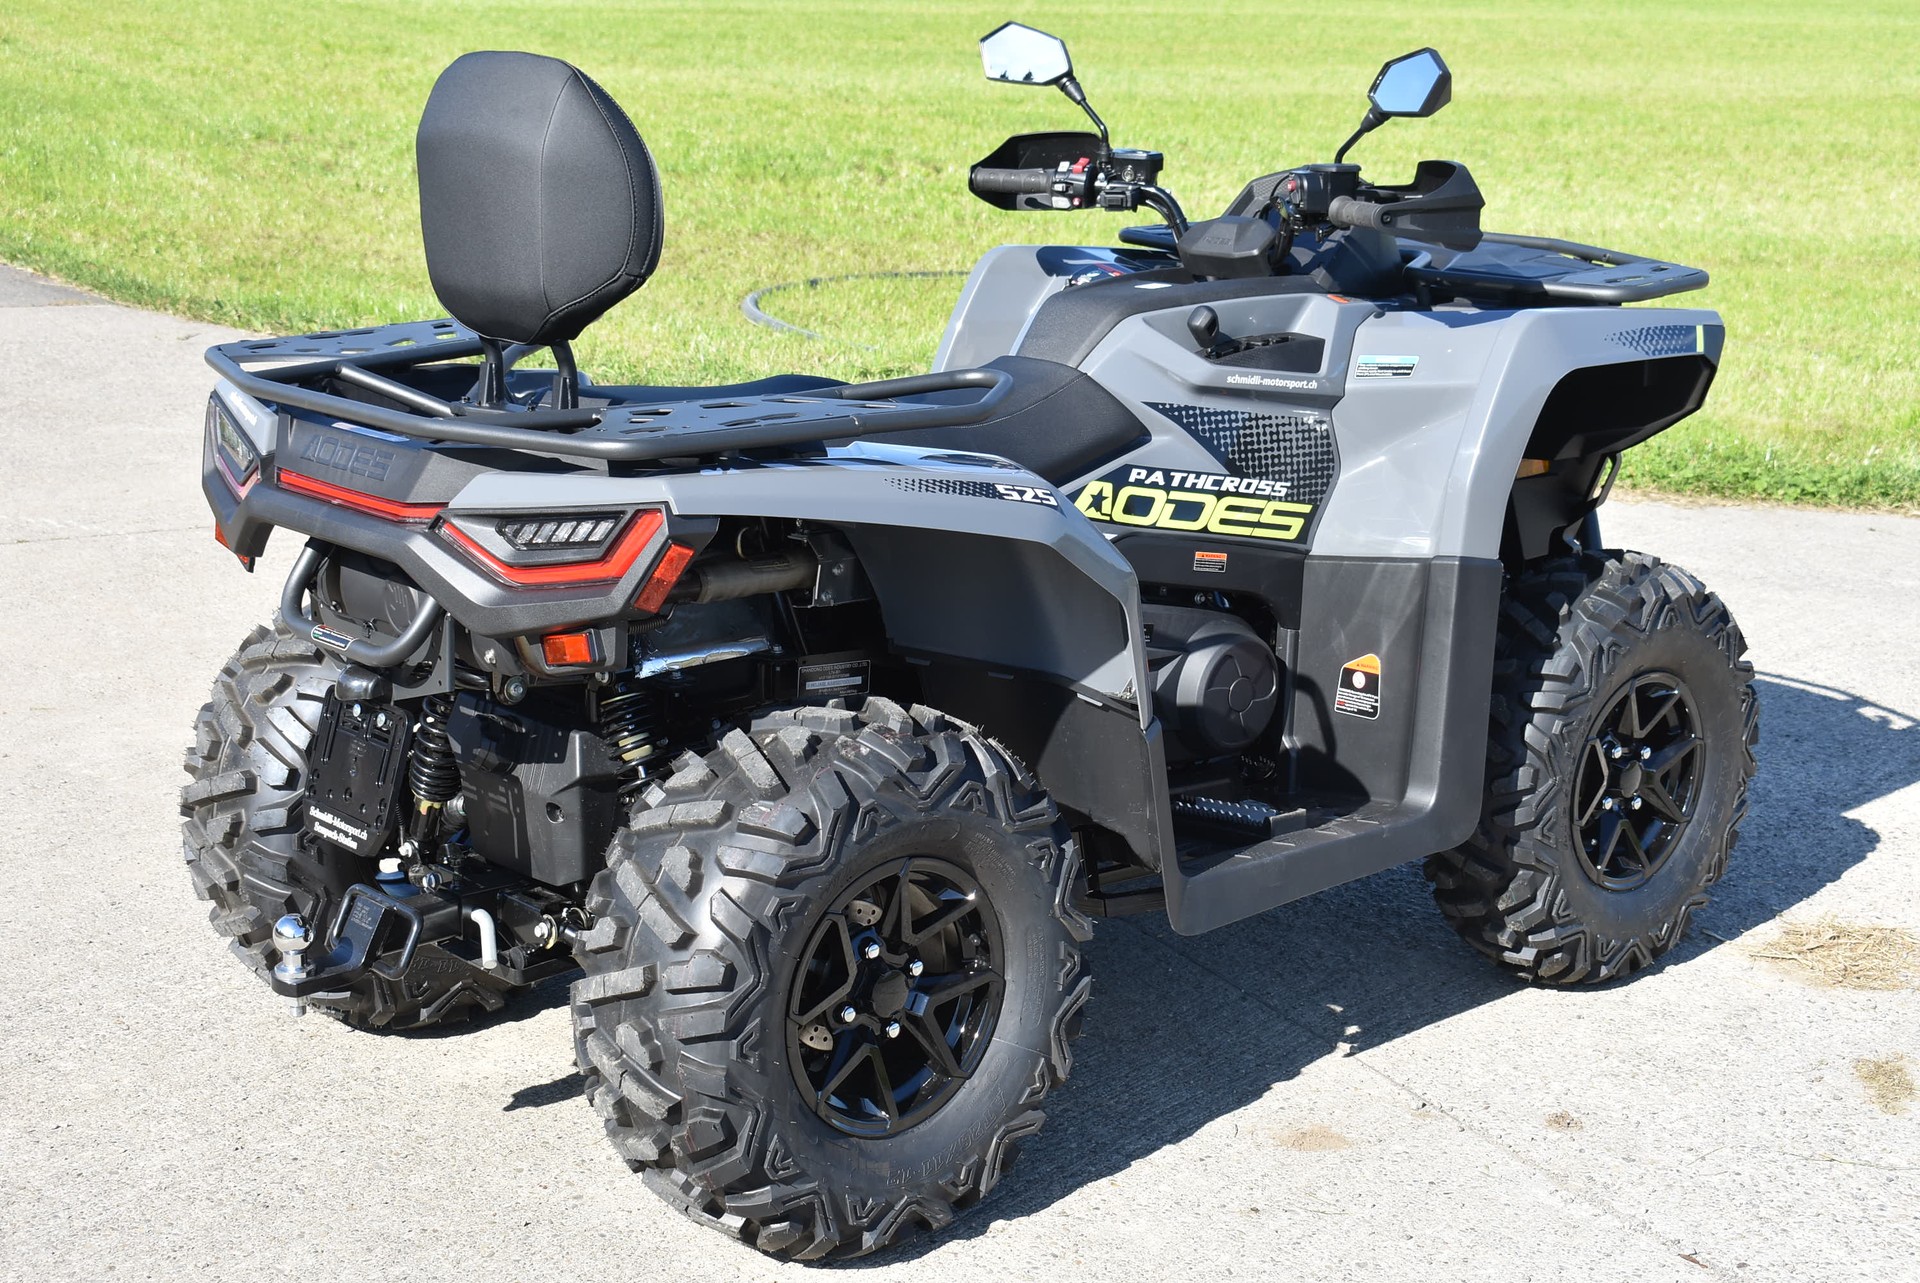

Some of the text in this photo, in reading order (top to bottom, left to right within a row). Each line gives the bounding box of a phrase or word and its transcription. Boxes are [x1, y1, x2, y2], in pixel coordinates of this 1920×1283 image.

[1226, 374, 1318, 390] schmidli-motorsport.ch
[994, 483, 1059, 507] 525
[1128, 468, 1292, 497] PATHCROSS
[1074, 480, 1313, 540] AODES
